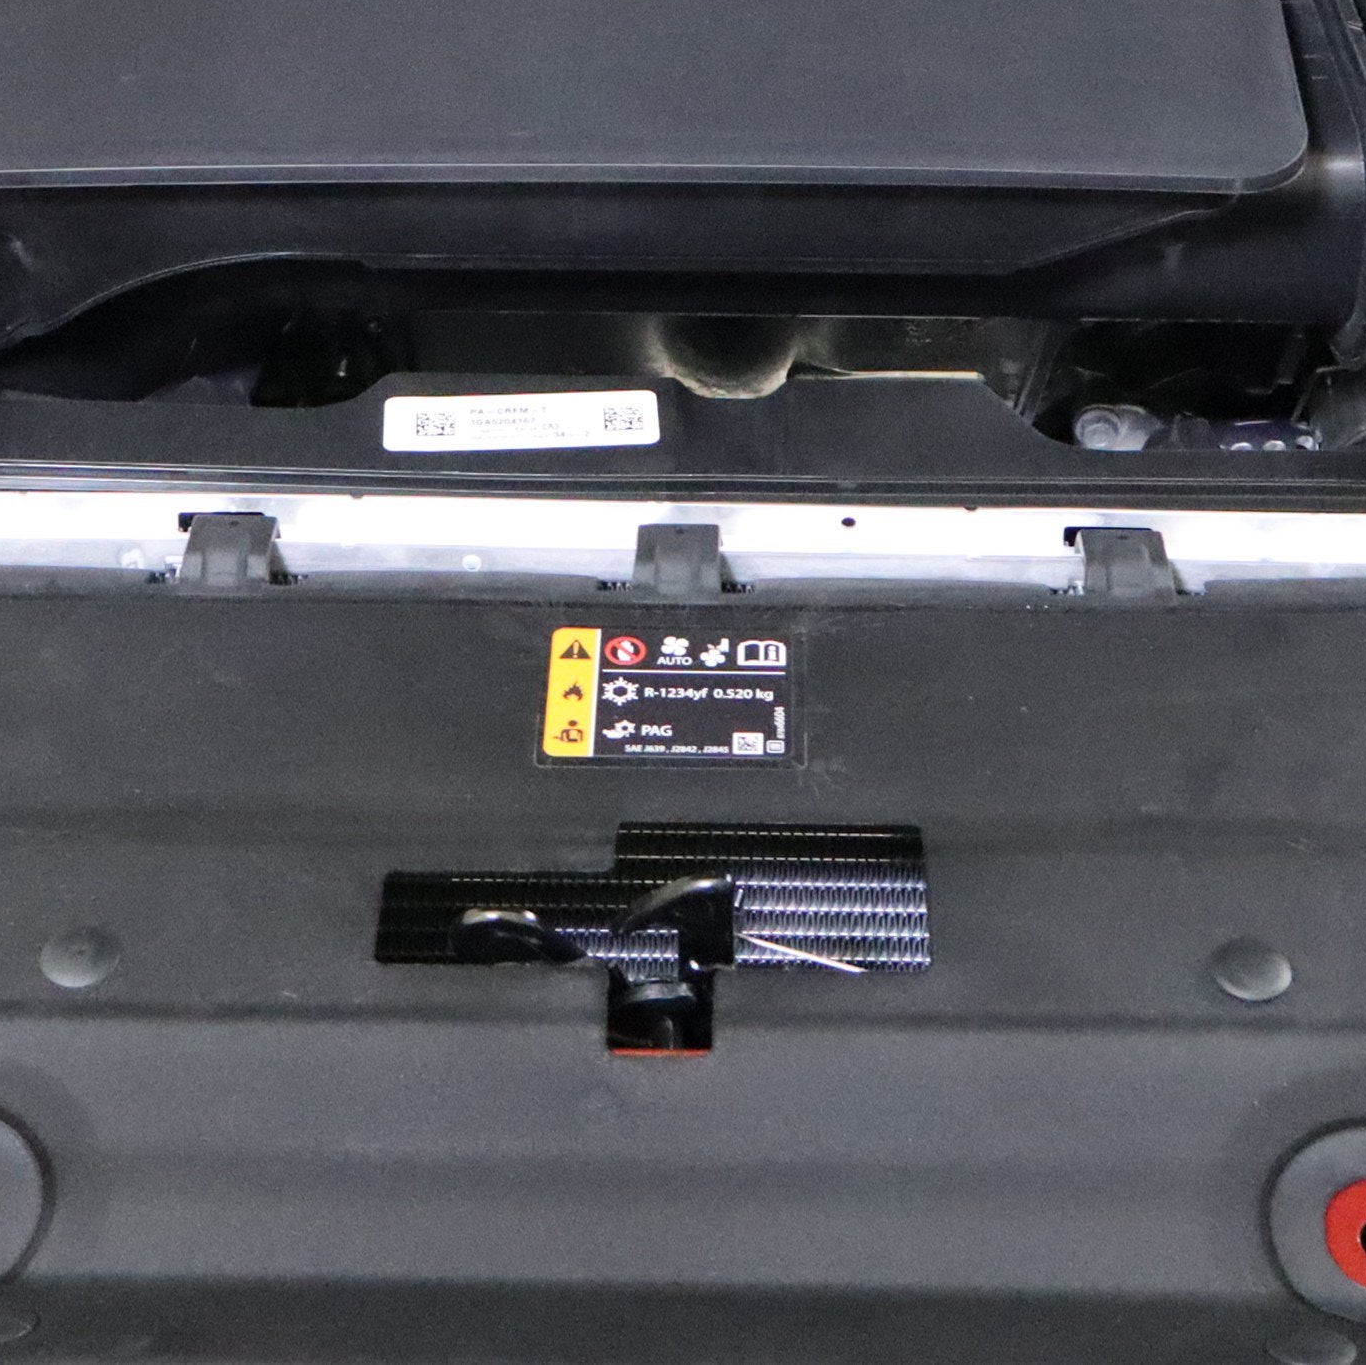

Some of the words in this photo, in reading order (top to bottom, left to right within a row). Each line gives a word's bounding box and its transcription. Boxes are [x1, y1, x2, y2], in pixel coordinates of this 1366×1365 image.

[657, 657, 693, 666] AUTO
[644, 687, 709, 700] R-1234yf
[712, 688, 753, 699] 0.520
[755, 688, 774, 702] kg
[641, 725, 673, 736] PAG
[624, 745, 642, 753] SAE
